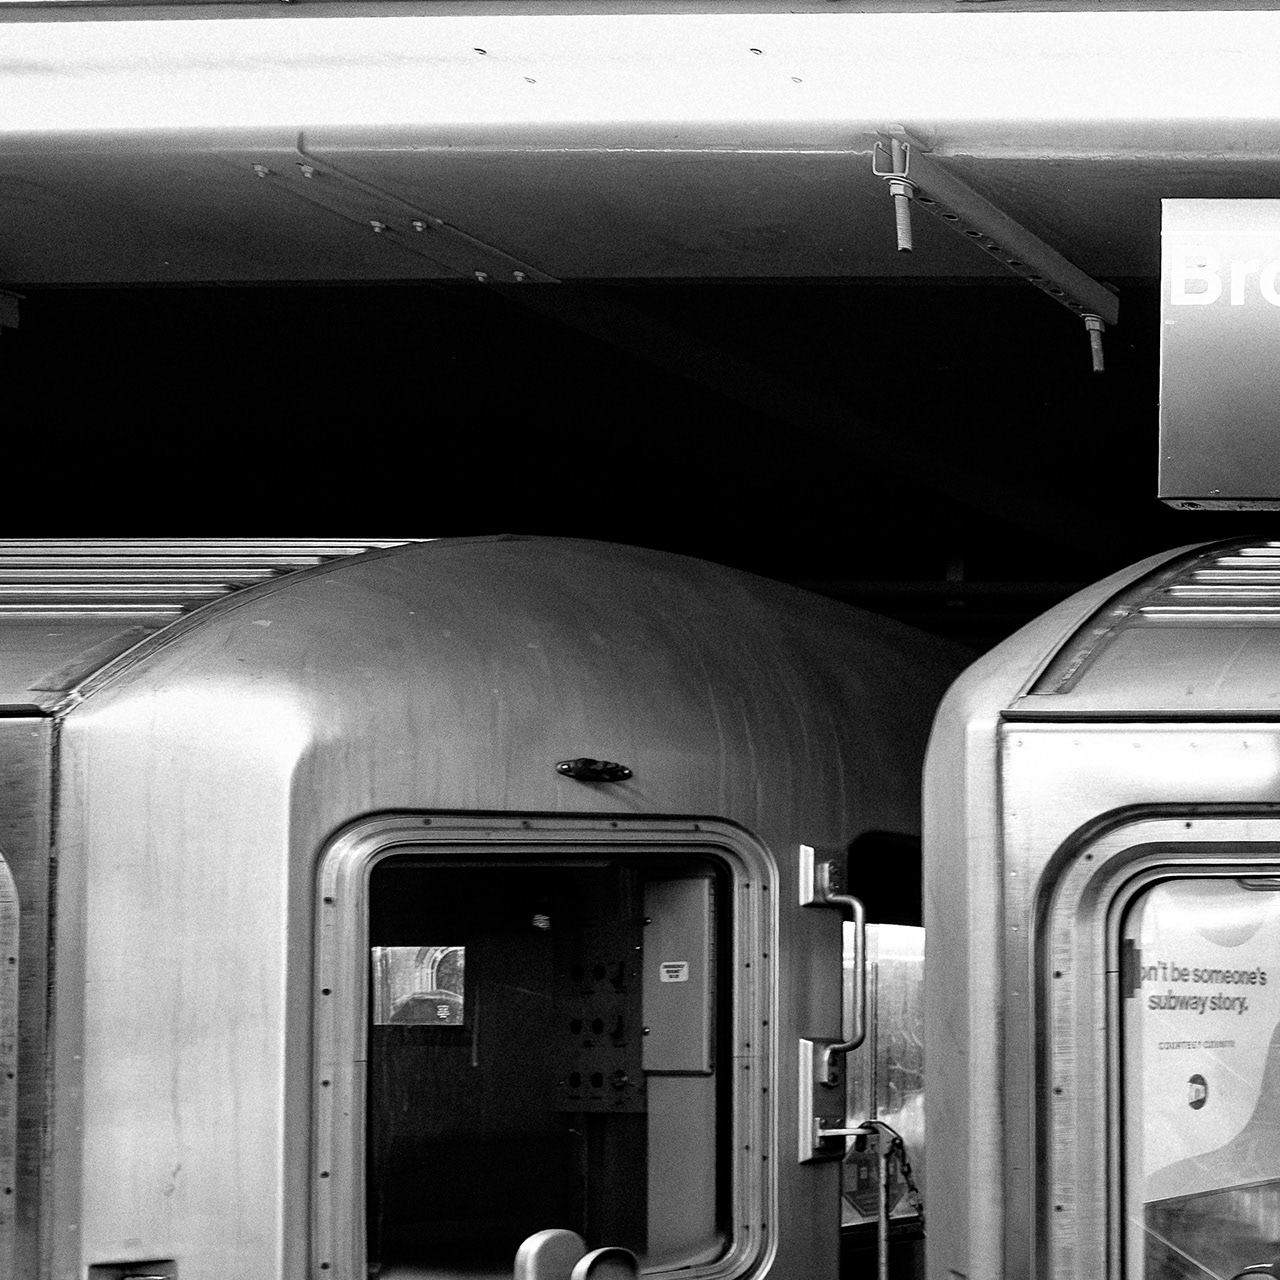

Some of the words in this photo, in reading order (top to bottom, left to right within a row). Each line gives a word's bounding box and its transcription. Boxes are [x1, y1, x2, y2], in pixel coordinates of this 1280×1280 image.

[1171, 961, 1189, 982] be
[1192, 966, 1267, 985] someone's
[1148, 989, 1208, 1015] subway
[1209, 992, 1248, 1015] story.
